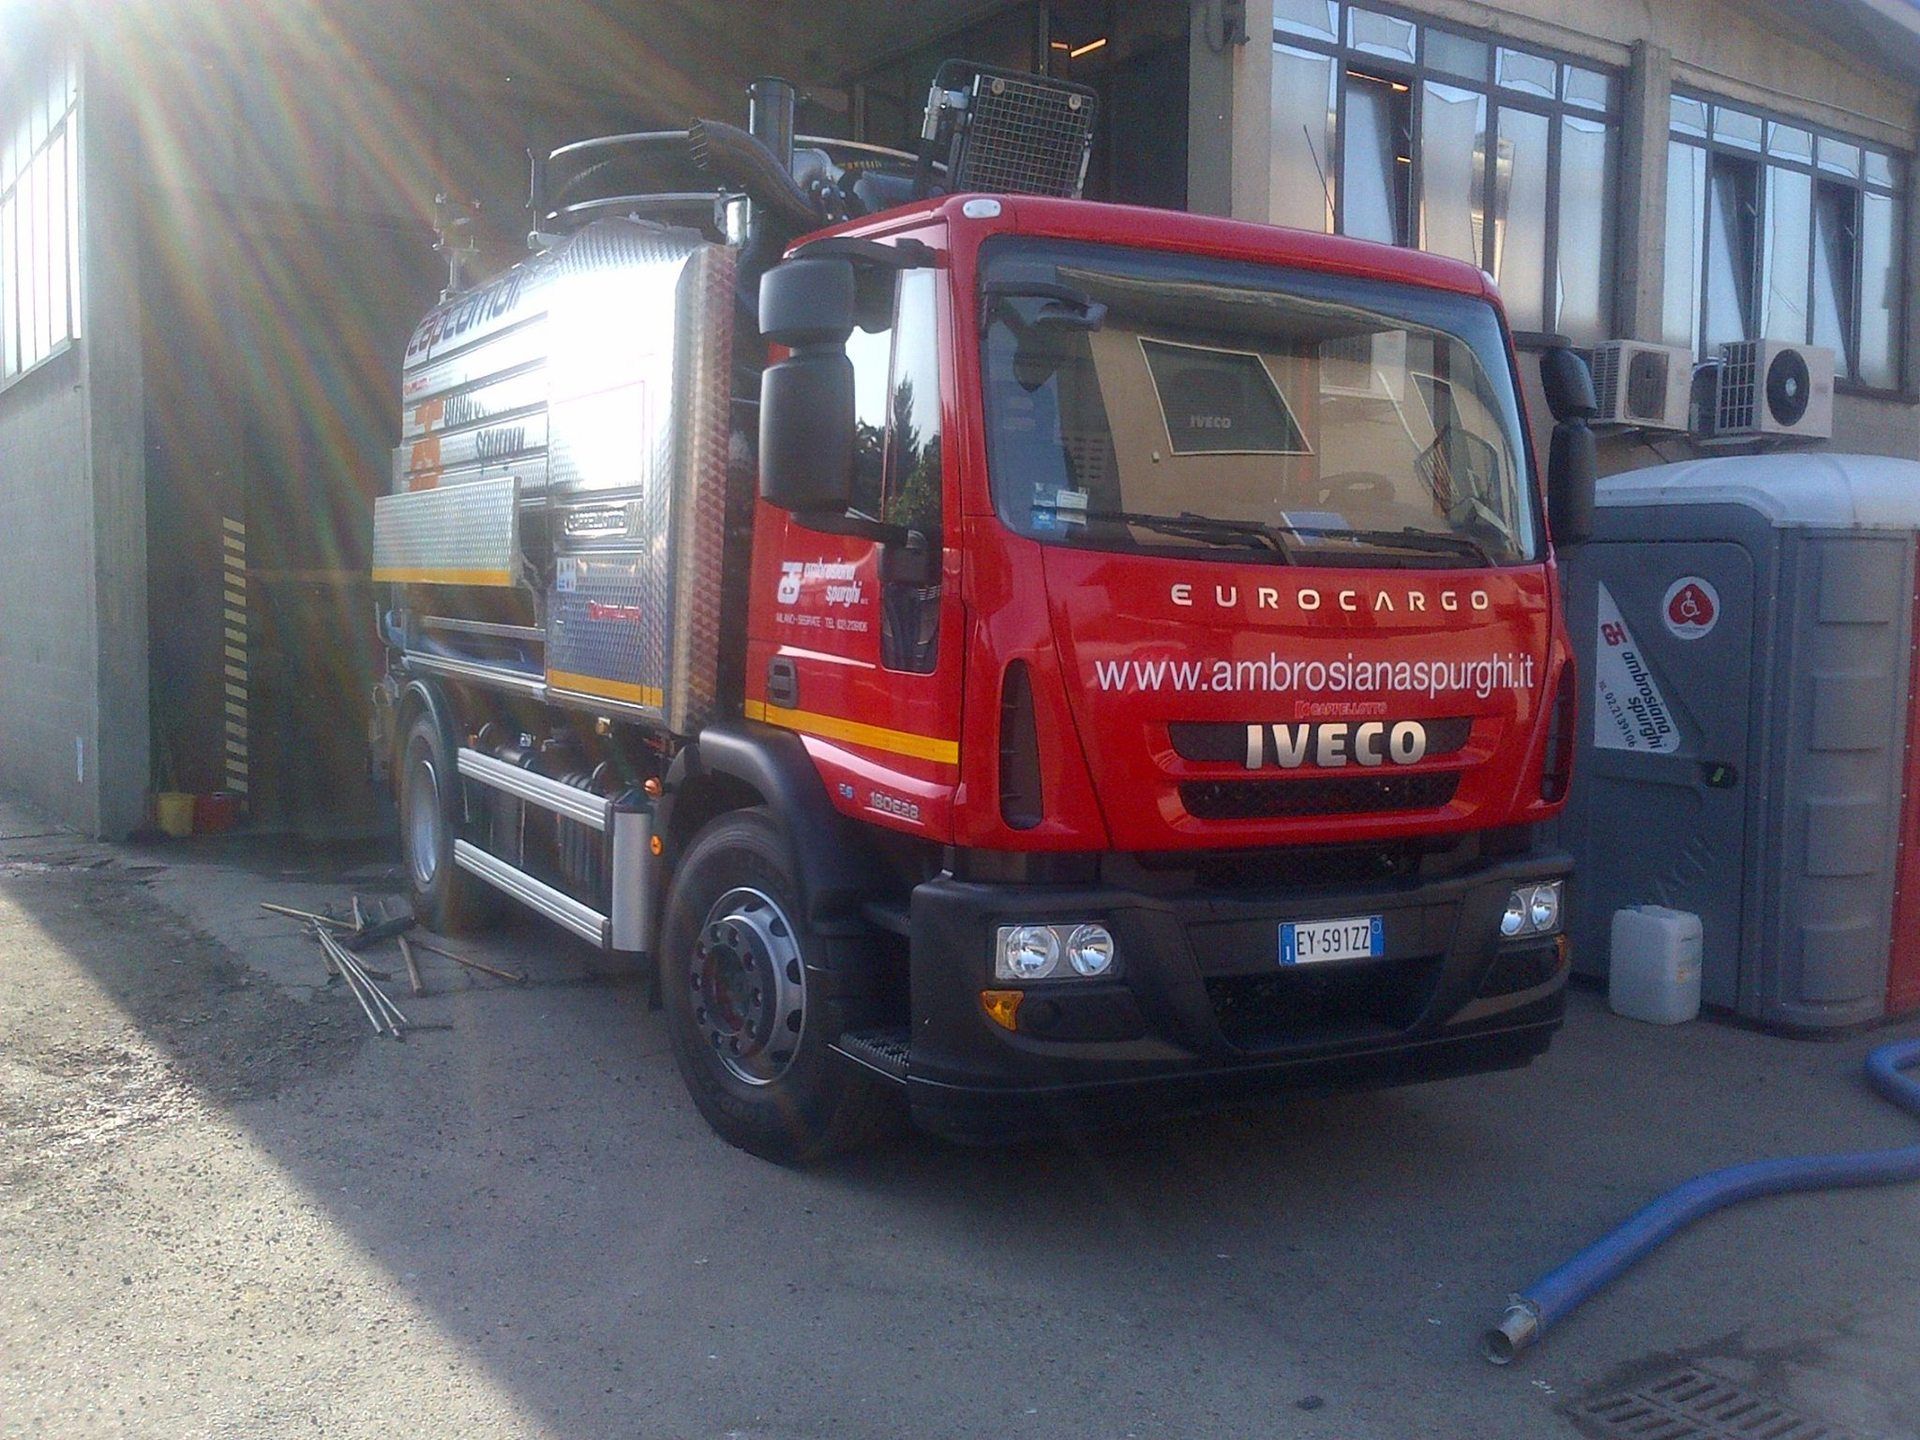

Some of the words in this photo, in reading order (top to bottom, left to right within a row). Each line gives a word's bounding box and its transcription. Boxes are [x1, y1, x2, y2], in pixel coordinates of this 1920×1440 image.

[1189, 415, 1232, 429] IVECO
[1171, 584, 1489, 611] EUROCARGO
[1095, 652, 1534, 699] www.ambrosianaspurghi.it
[1622, 651, 1671, 734] ambrosiana
[1246, 720, 1427, 770] IVECO
[1605, 692, 1636, 748] 02.2139106
[1628, 696, 1668, 749] spurghi
